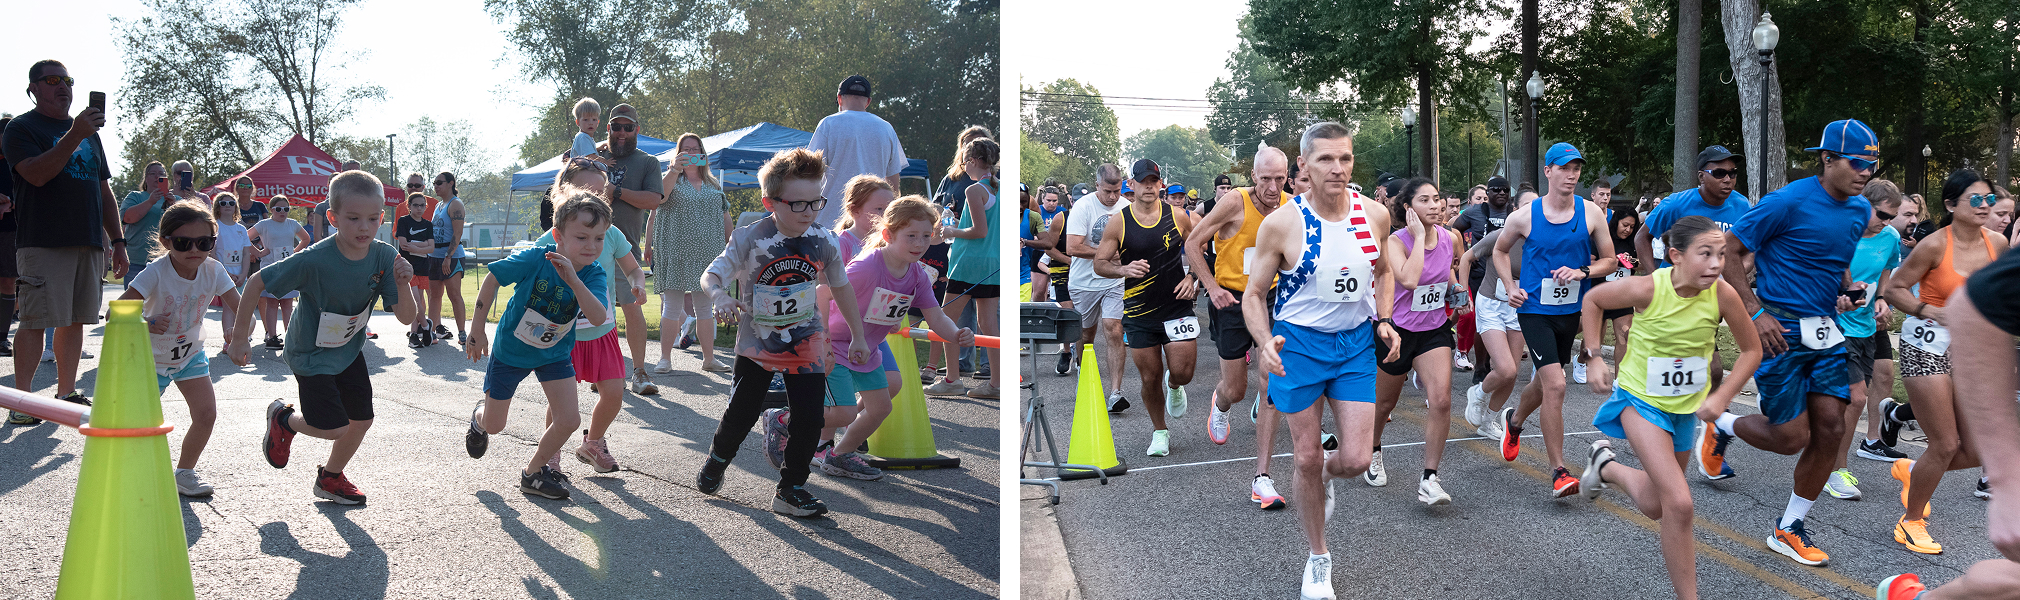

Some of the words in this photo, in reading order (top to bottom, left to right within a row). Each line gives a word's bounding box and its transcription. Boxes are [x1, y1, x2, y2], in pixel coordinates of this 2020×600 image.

[283, 155, 337, 176] HS
[256, 184, 329, 197] althSourc
[774, 260, 801, 273] GROVE
[1334, 277, 1358, 293] 50
[1420, 292, 1440, 305] 108
[1552, 287, 1569, 298] 59
[773, 298, 798, 316] 12
[886, 305, 909, 318] 16
[1173, 323, 1195, 335] 106
[1816, 326, 1830, 340] 67
[1913, 326, 1936, 343] 90
[541, 332, 554, 343] 8
[170, 342, 193, 361] 17
[1661, 371, 1694, 386] 101
